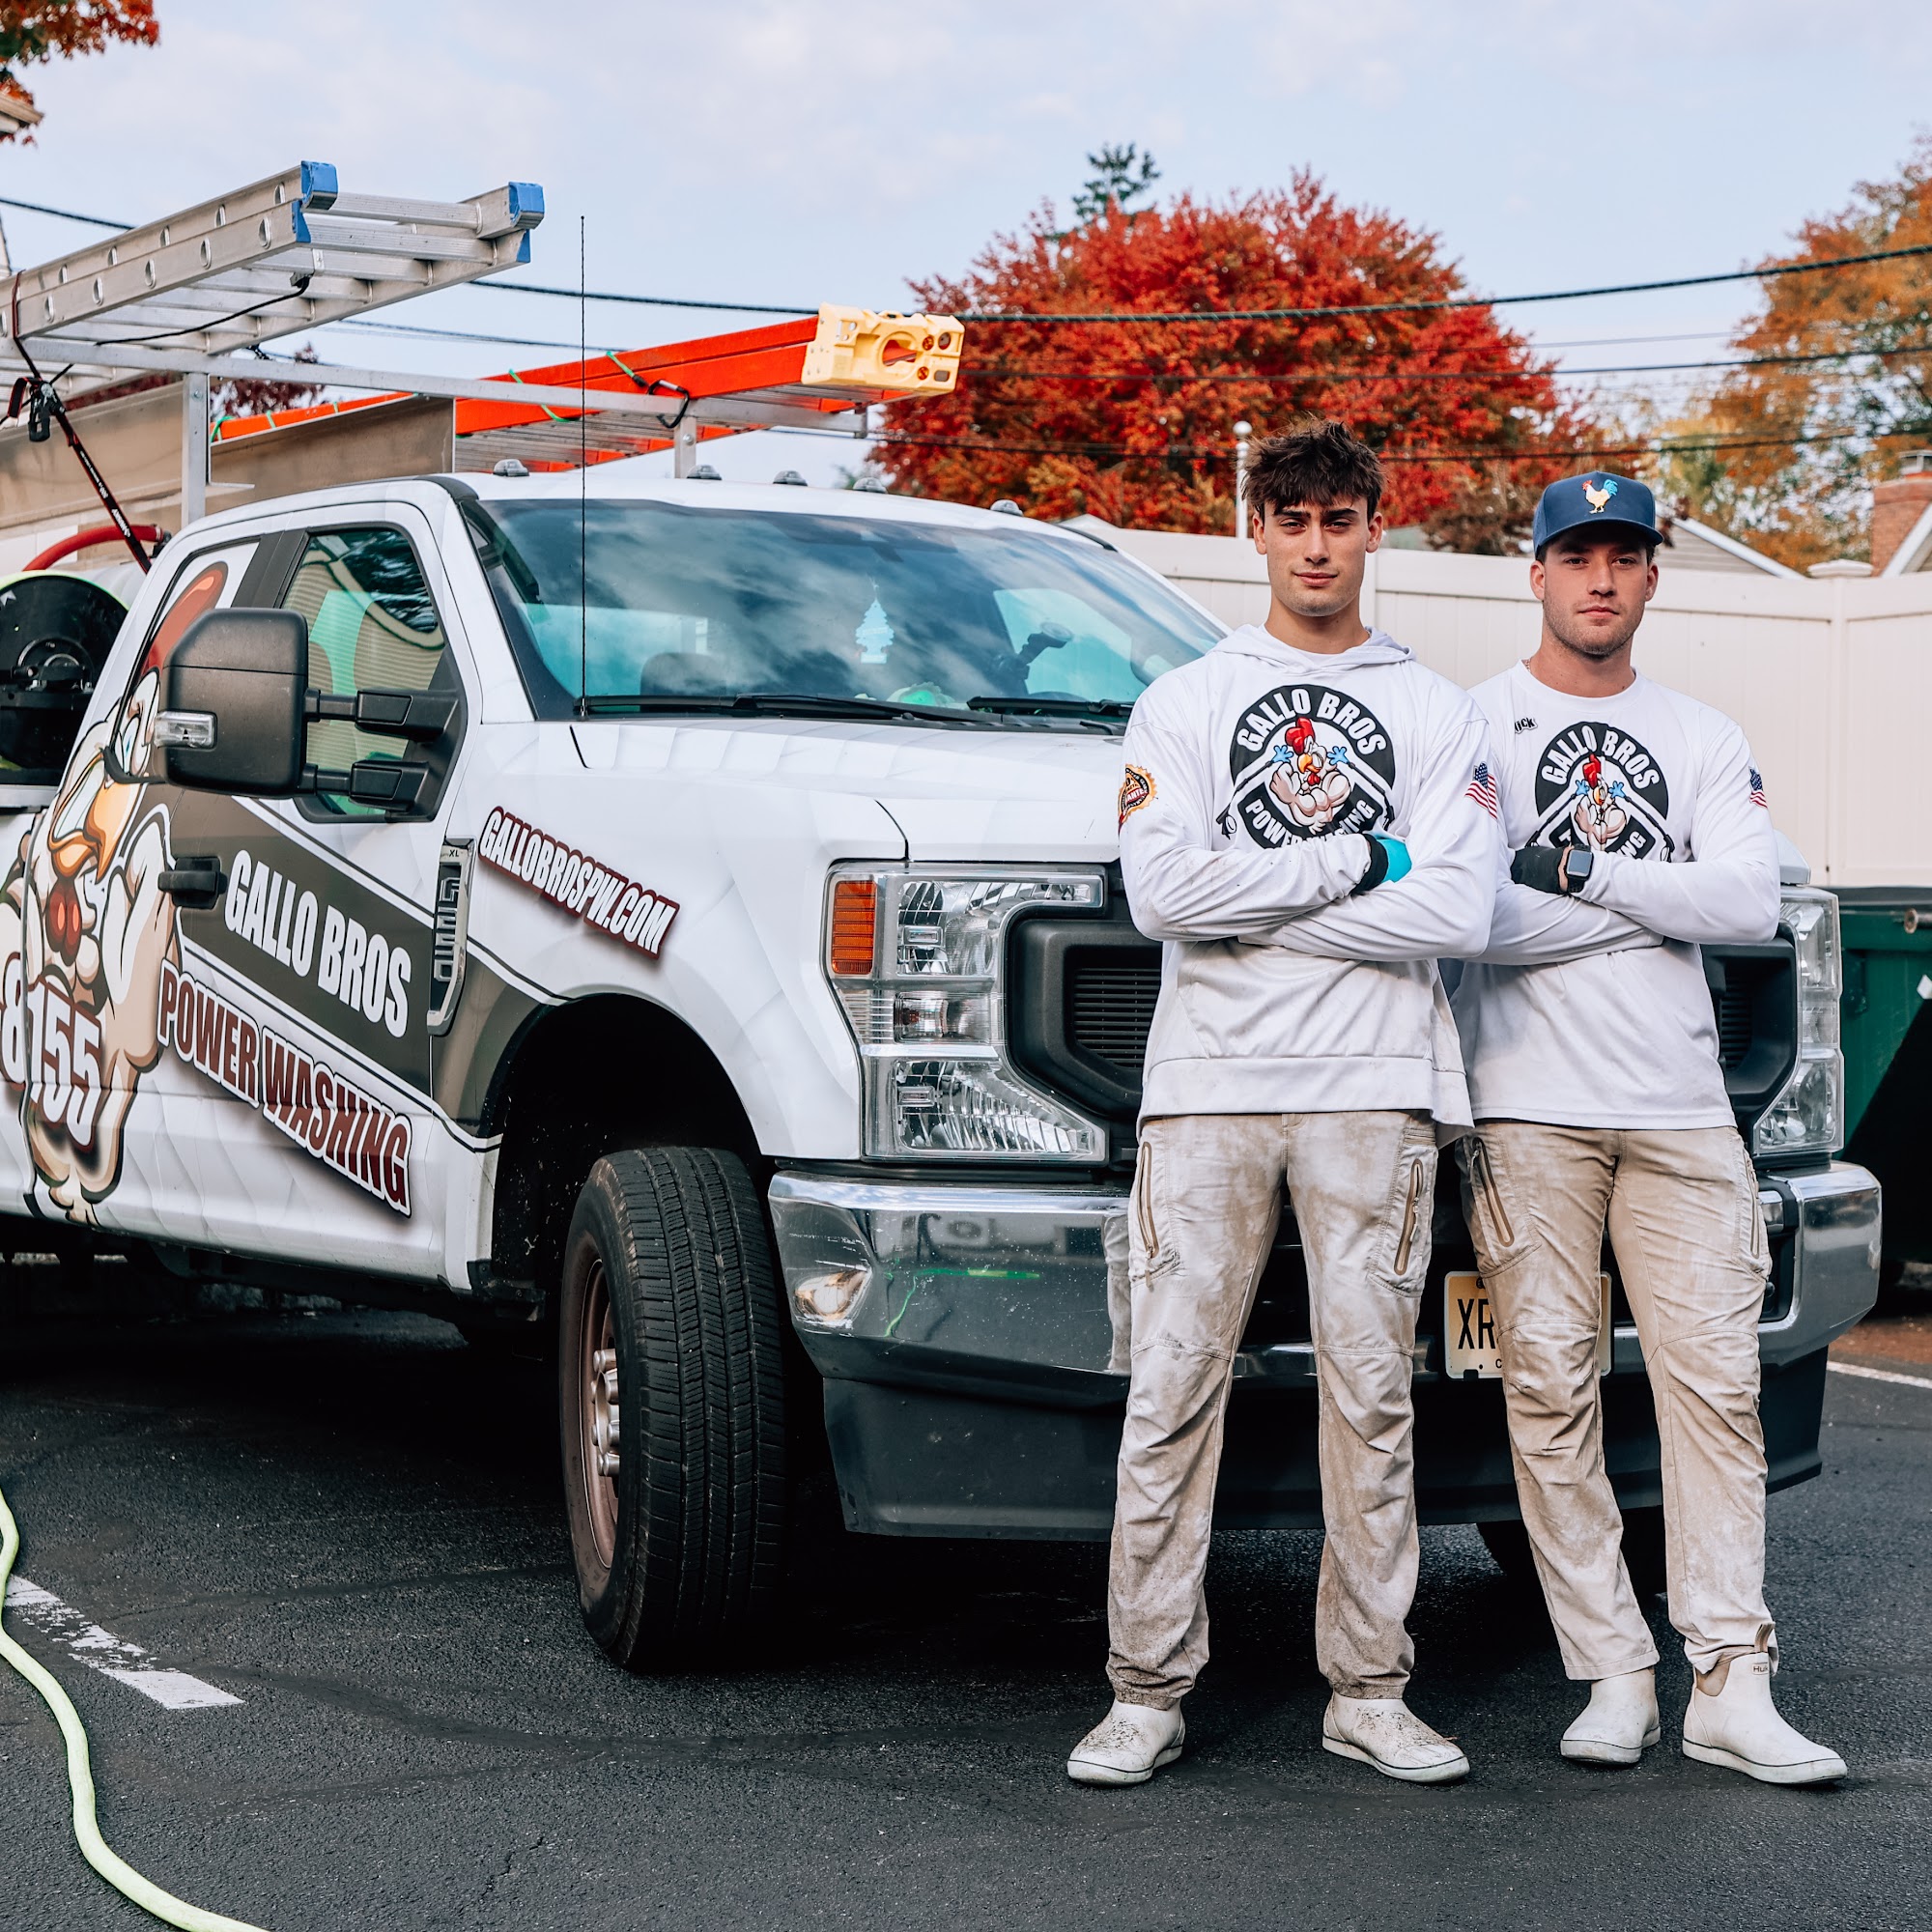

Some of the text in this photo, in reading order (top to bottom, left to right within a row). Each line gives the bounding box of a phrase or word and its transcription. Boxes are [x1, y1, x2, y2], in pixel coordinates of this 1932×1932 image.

[1236, 689, 1386, 754] GALLO BROS
[1541, 724, 1660, 789] GALLO BROS
[225, 849, 412, 1038] GALLO BROS
[479, 808, 677, 956] GALLOBROSPW.COM
[158, 962, 410, 1212] POWER WASHING
